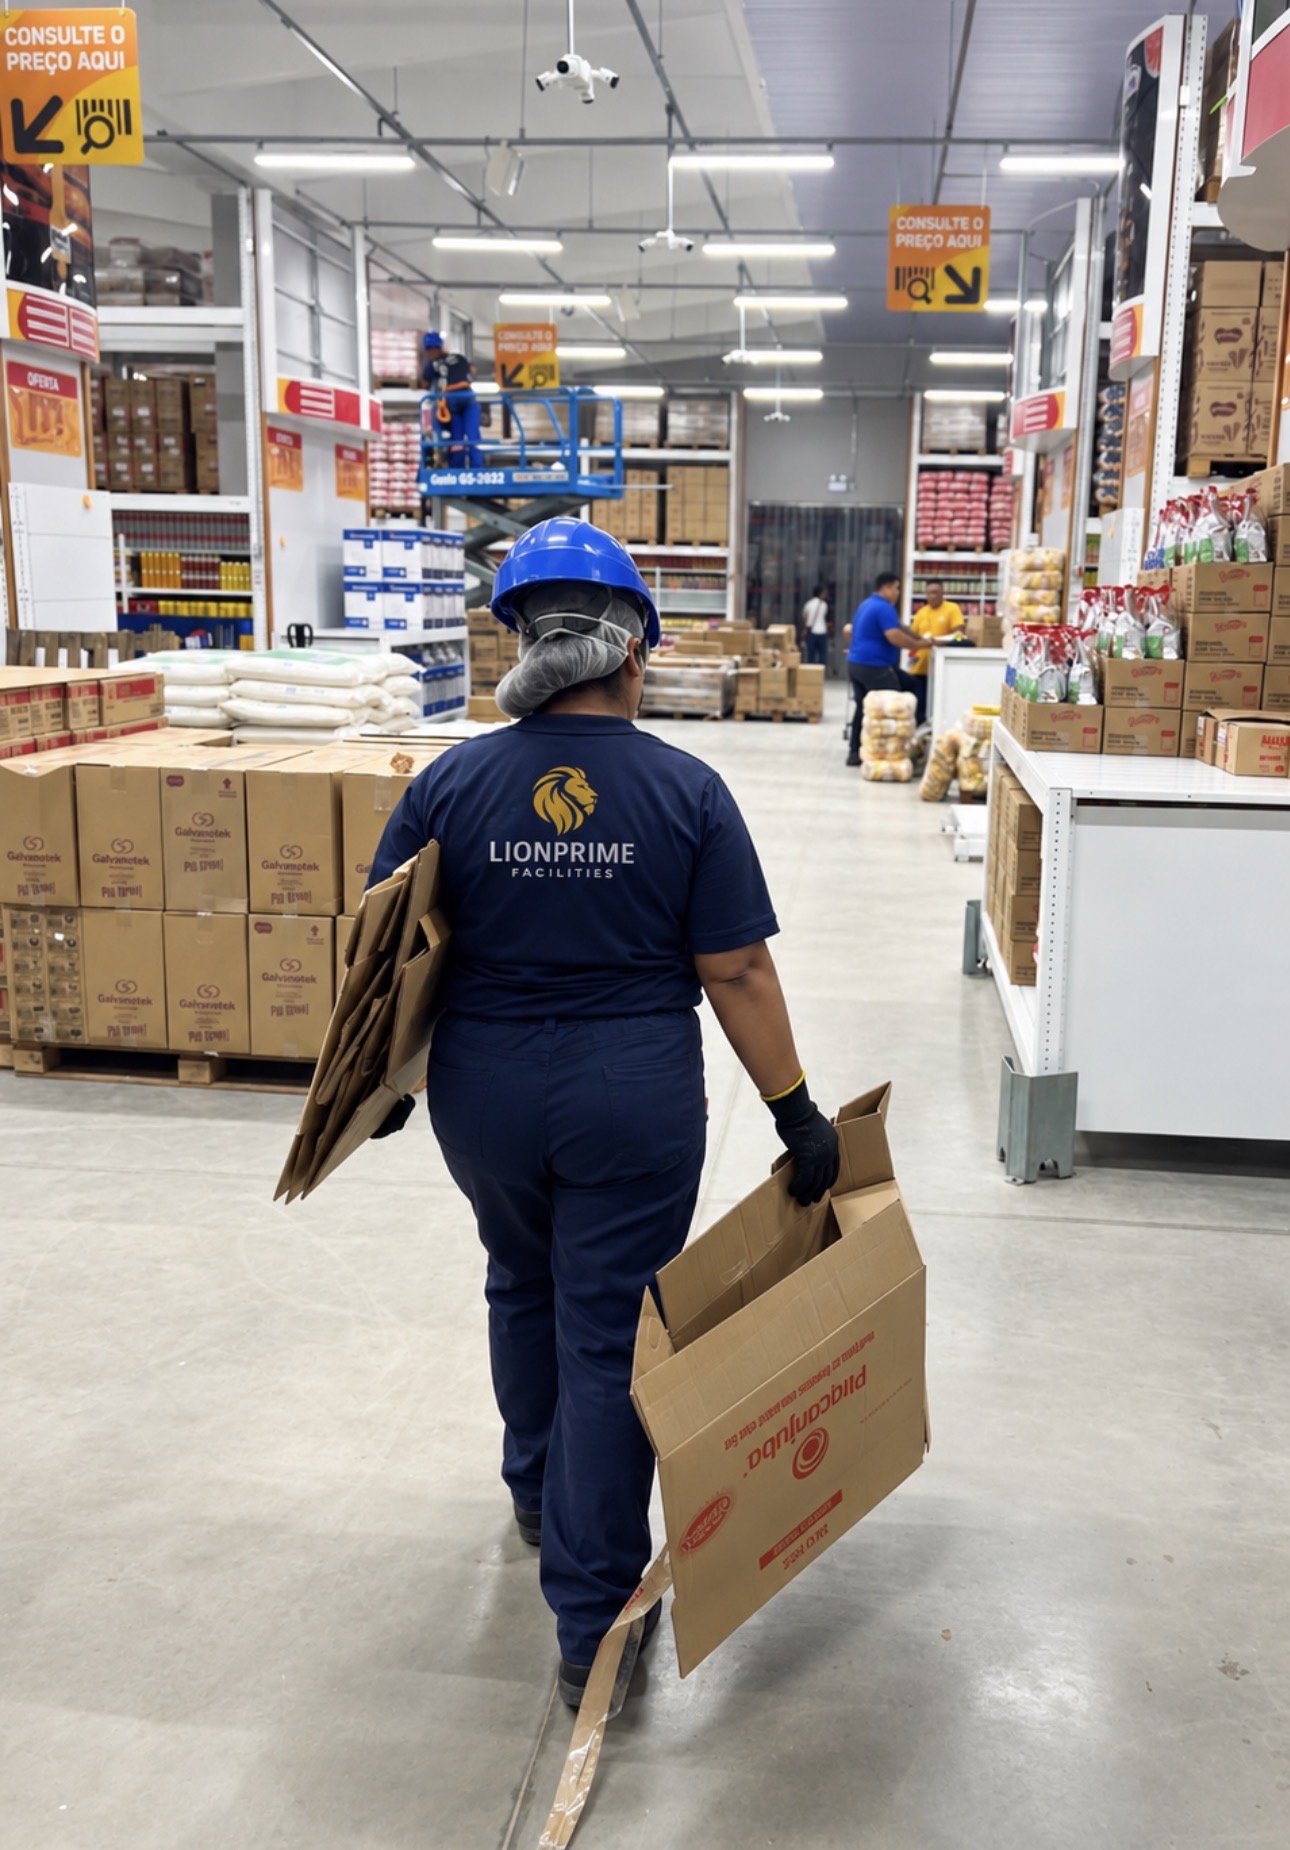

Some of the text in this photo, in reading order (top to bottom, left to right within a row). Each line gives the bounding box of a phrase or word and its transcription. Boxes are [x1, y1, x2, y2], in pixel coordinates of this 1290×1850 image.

[5, 25, 125, 46] CONSULTE O
[6, 51, 125, 76] PREÇO AQUI
[896, 216, 984, 231] CONSULTE O
[895, 234, 982, 251] PREÇO AQUI
[489, 841, 635, 864] LIONPRIME
[511, 868, 614, 879] FACILITIES
